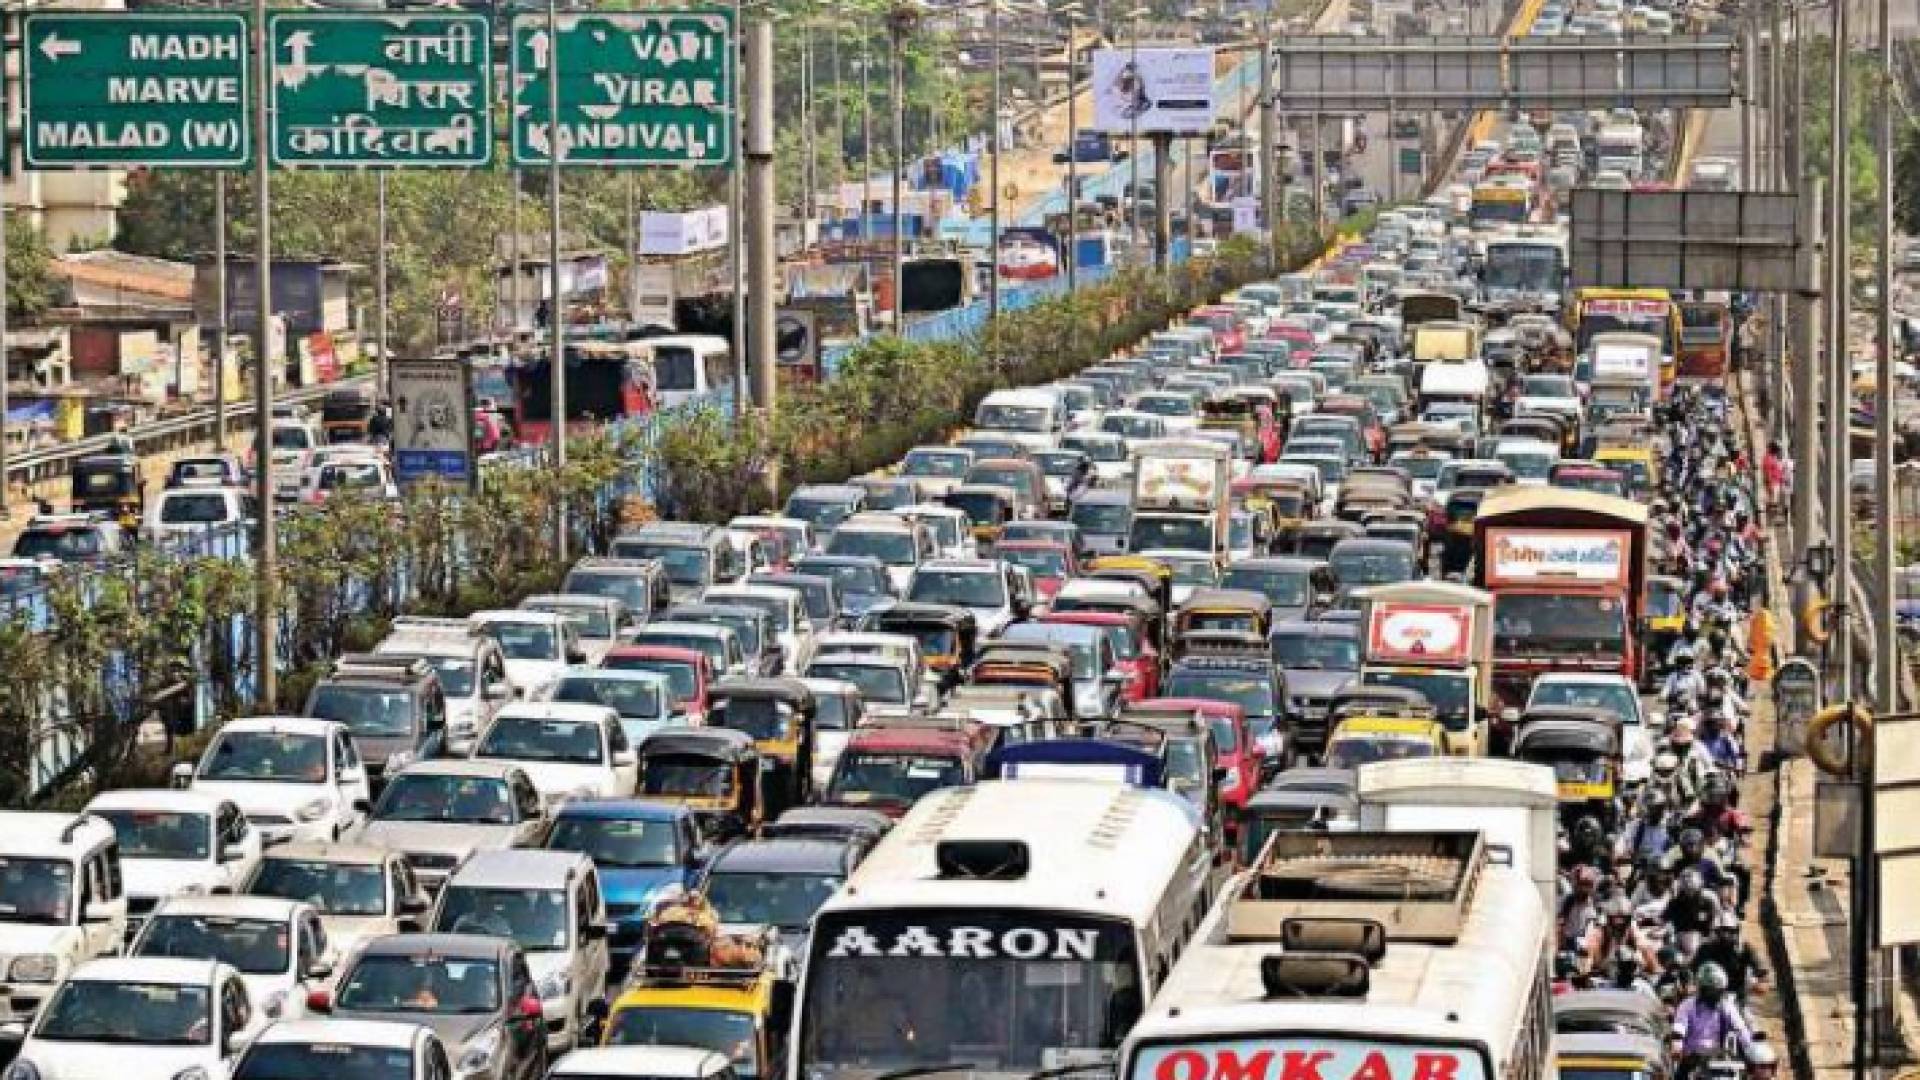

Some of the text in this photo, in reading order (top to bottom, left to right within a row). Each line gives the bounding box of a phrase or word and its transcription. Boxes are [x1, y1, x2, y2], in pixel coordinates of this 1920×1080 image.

[129, 34, 238, 60] MADH
[384, 24, 475, 63] वापी
[631, 31, 714, 66] VAPI
[107, 76, 239, 103] MARVE
[602, 74, 716, 104] VIRAR
[37, 119, 239, 151] MALAD (W)
[288, 112, 477, 157] कांदिवली
[528, 122, 717, 155] KANDIVALI
[826, 925, 1100, 959] AARON
[1155, 1049, 1460, 1080] OMKAR
